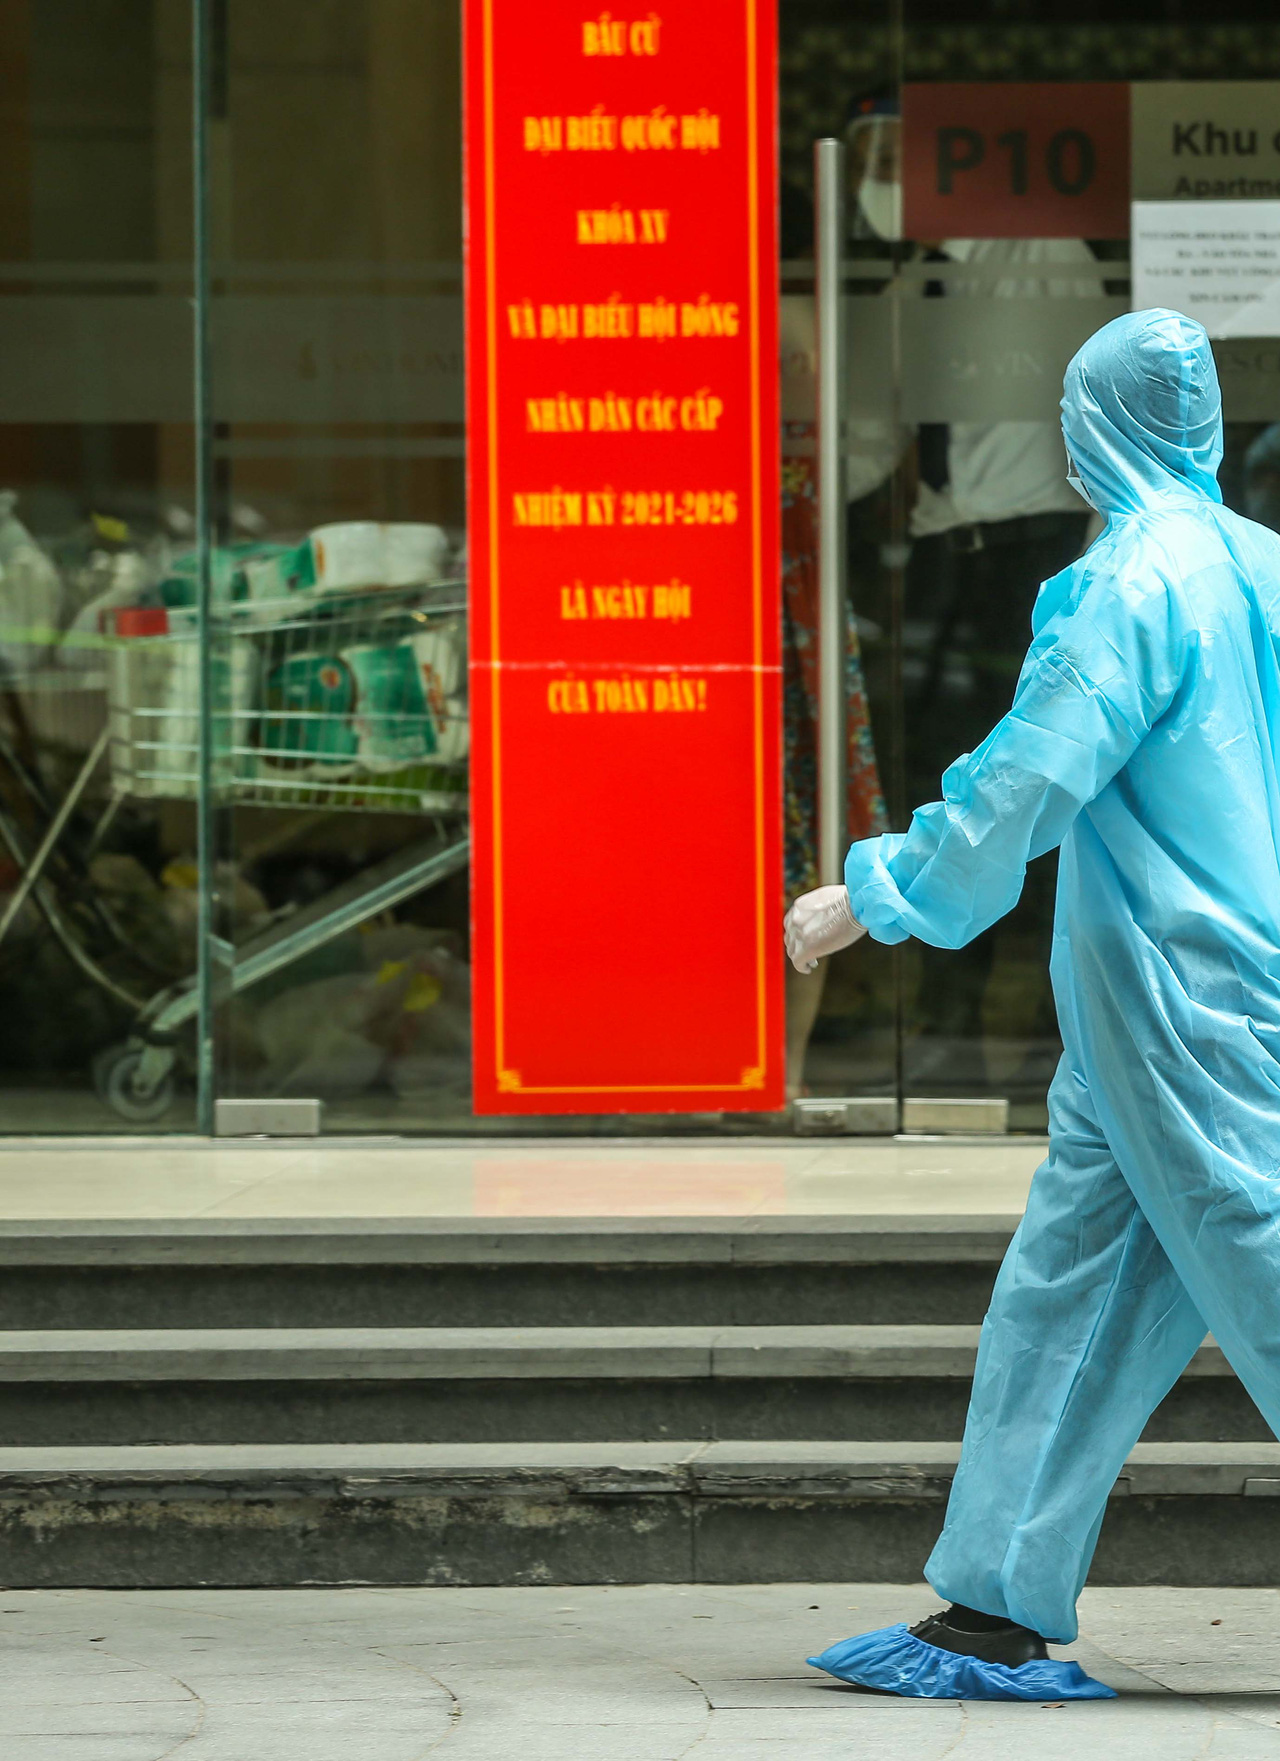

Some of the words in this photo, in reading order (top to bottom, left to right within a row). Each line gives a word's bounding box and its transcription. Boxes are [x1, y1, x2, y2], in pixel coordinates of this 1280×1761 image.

[524, 116, 563, 156] ĐẠI
[567, 103, 617, 151] BIỂU
[621, 104, 678, 153] QUỐC
[681, 107, 720, 155] HỘI
[1172, 123, 1258, 156] Khu
[935, 127, 1096, 195] P10
[576, 202, 636, 244] KHÓA
[639, 209, 669, 244] XV
[508, 297, 537, 339] VÀ
[541, 303, 578, 345] ĐẠI
[583, 291, 633, 339] BIỂU
[637, 295, 677, 343] HỘI
[681, 292, 739, 338] ĐỒNG
[526, 390, 585, 432] NHÂN
[588, 390, 632, 432] DÂN
[636, 390, 677, 432] CÁC
[680, 386, 723, 431] CẤP
[513, 485, 582, 532] NHIỆM
[621, 490, 738, 526] 2021-2026
[561, 578, 588, 619] LÀ
[592, 578, 648, 619] NGÀY
[653, 577, 692, 624] HỘI
[548, 671, 589, 713] CỦA
[594, 672, 649, 713] TOÀN
[653, 672, 708, 713] DÂN!
